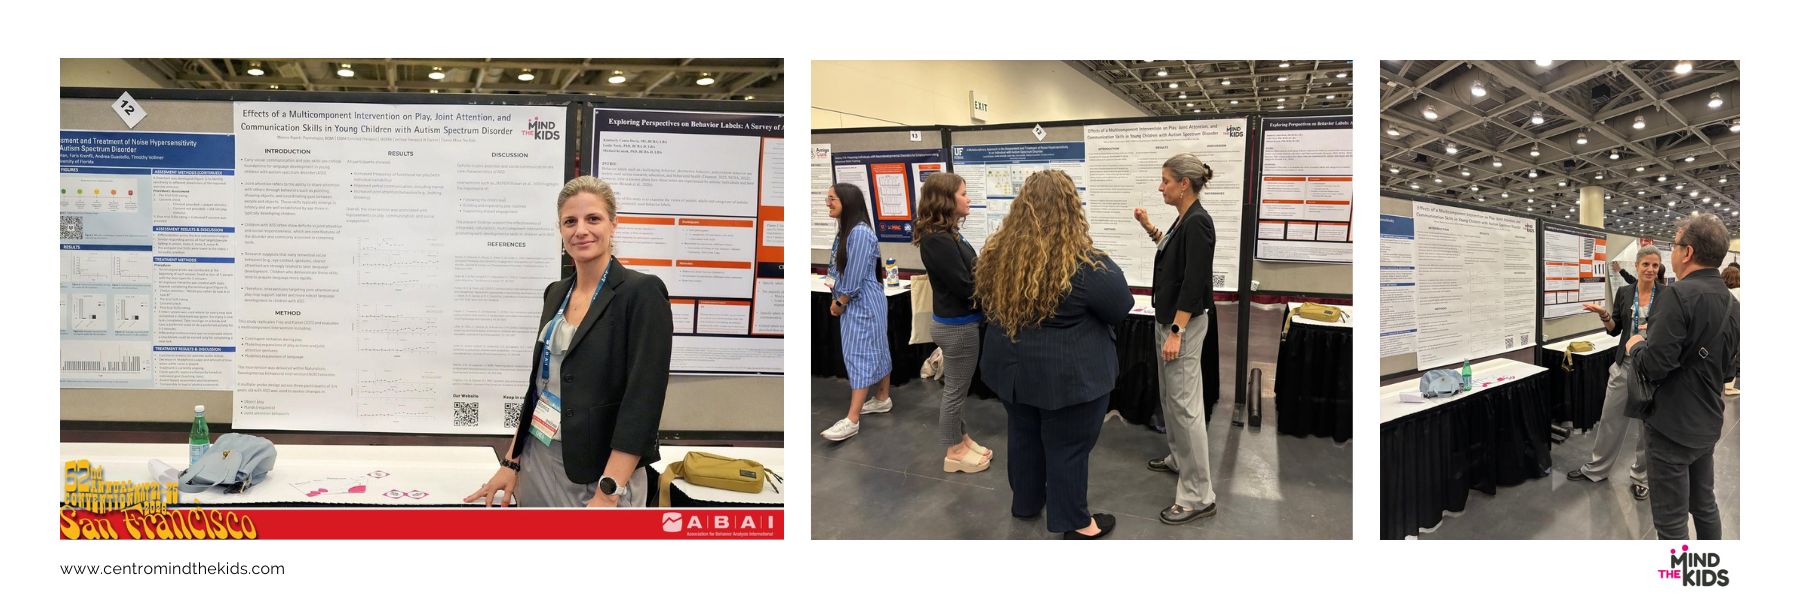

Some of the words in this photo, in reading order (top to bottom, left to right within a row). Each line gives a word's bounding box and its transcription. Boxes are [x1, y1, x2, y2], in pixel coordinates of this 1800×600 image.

[120, 100, 135, 116] 12
[974, 101, 988, 112] EXIT
[242, 109, 269, 118] Effects
[272, 110, 280, 118] of
[289, 110, 351, 119] Multicomponent
[354, 111, 400, 120] Intervention
[415, 113, 432, 122] Play,
[434, 113, 453, 121] Joint
[456, 113, 495, 122] Attention,
[497, 114, 511, 122] and
[241, 122, 300, 132] Communication
[302, 124, 322, 132] Skills
[325, 124, 332, 132] in
[334, 125, 358, 134] Young
[360, 125, 392, 133] Children
[395, 126, 412, 134] with
[415, 126, 440, 134] Autism
[443, 126, 479, 135] Spectrum
[482, 127, 513, 135] Disorder
[528, 119, 555, 130] MIND
[608, 118, 640, 127] Exploring
[641, 120, 680, 128] Perspectives
[720, 121, 743, 129] Labels:
[751, 123, 772, 131] Survey
[535, 130, 560, 140] KIDS
[81, 145, 111, 153] Spectrum
[150, 139, 197, 148] Hypersensitivity
[954, 147, 964, 156] UF
